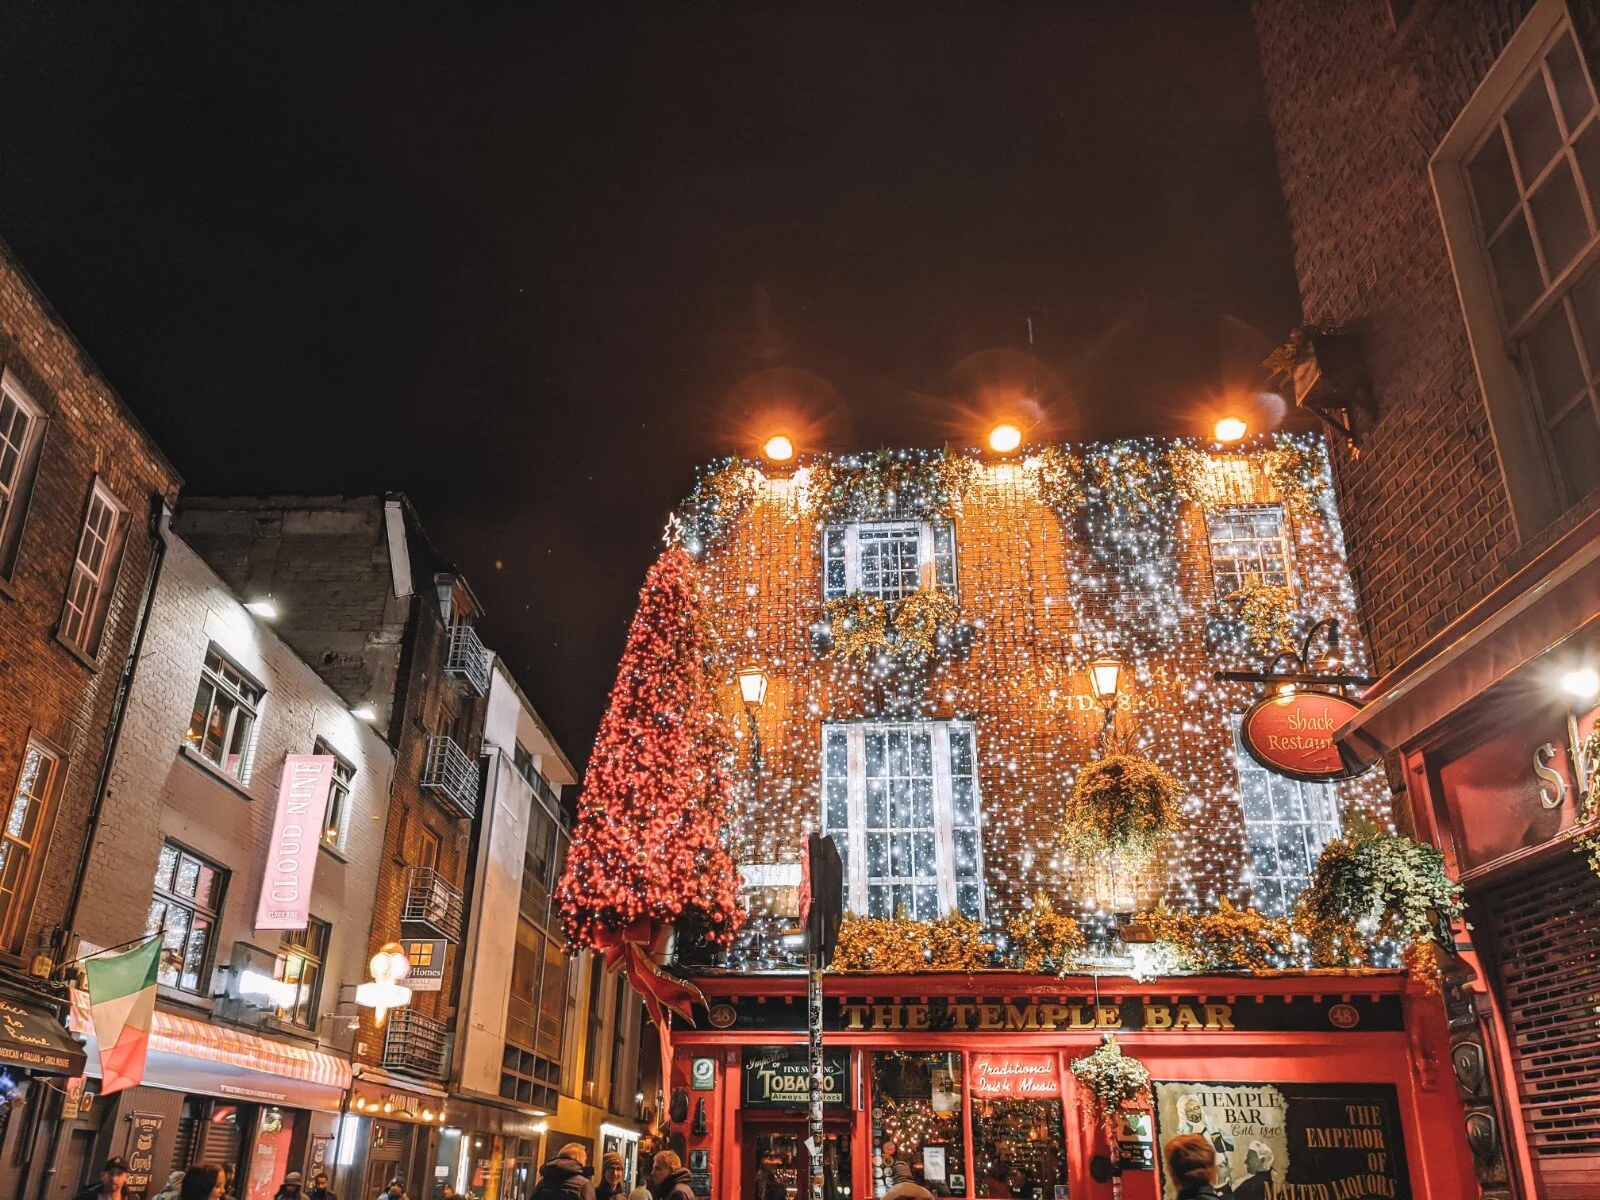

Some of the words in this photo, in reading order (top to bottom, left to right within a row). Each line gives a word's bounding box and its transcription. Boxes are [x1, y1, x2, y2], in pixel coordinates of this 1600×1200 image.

[1288, 708, 1336, 733] Shack
[271, 824, 303, 903] CLOUD
[287, 761, 324, 815] NINE
[842, 1004, 929, 1029] THE
[948, 1004, 1122, 1029] TEMPLE
[1143, 1004, 1235, 1030] BAR
[979, 1060, 1052, 1076] Traditional
[757, 1070, 834, 1098] TOBAO
[979, 1077, 1011, 1092] Irish
[1018, 1077, 1057, 1092] Music
[773, 1093, 802, 1102] Always
[1197, 1092, 1281, 1107] TEMPLE
[1224, 1108, 1265, 1125] BAR
[1345, 1105, 1381, 1126] THE
[1305, 1127, 1385, 1149] EMPEROR
[1367, 1152, 1387, 1172] OF
[1264, 1181, 1330, 1200] MALTED
[1331, 1173, 1397, 1200] LIQUORS
